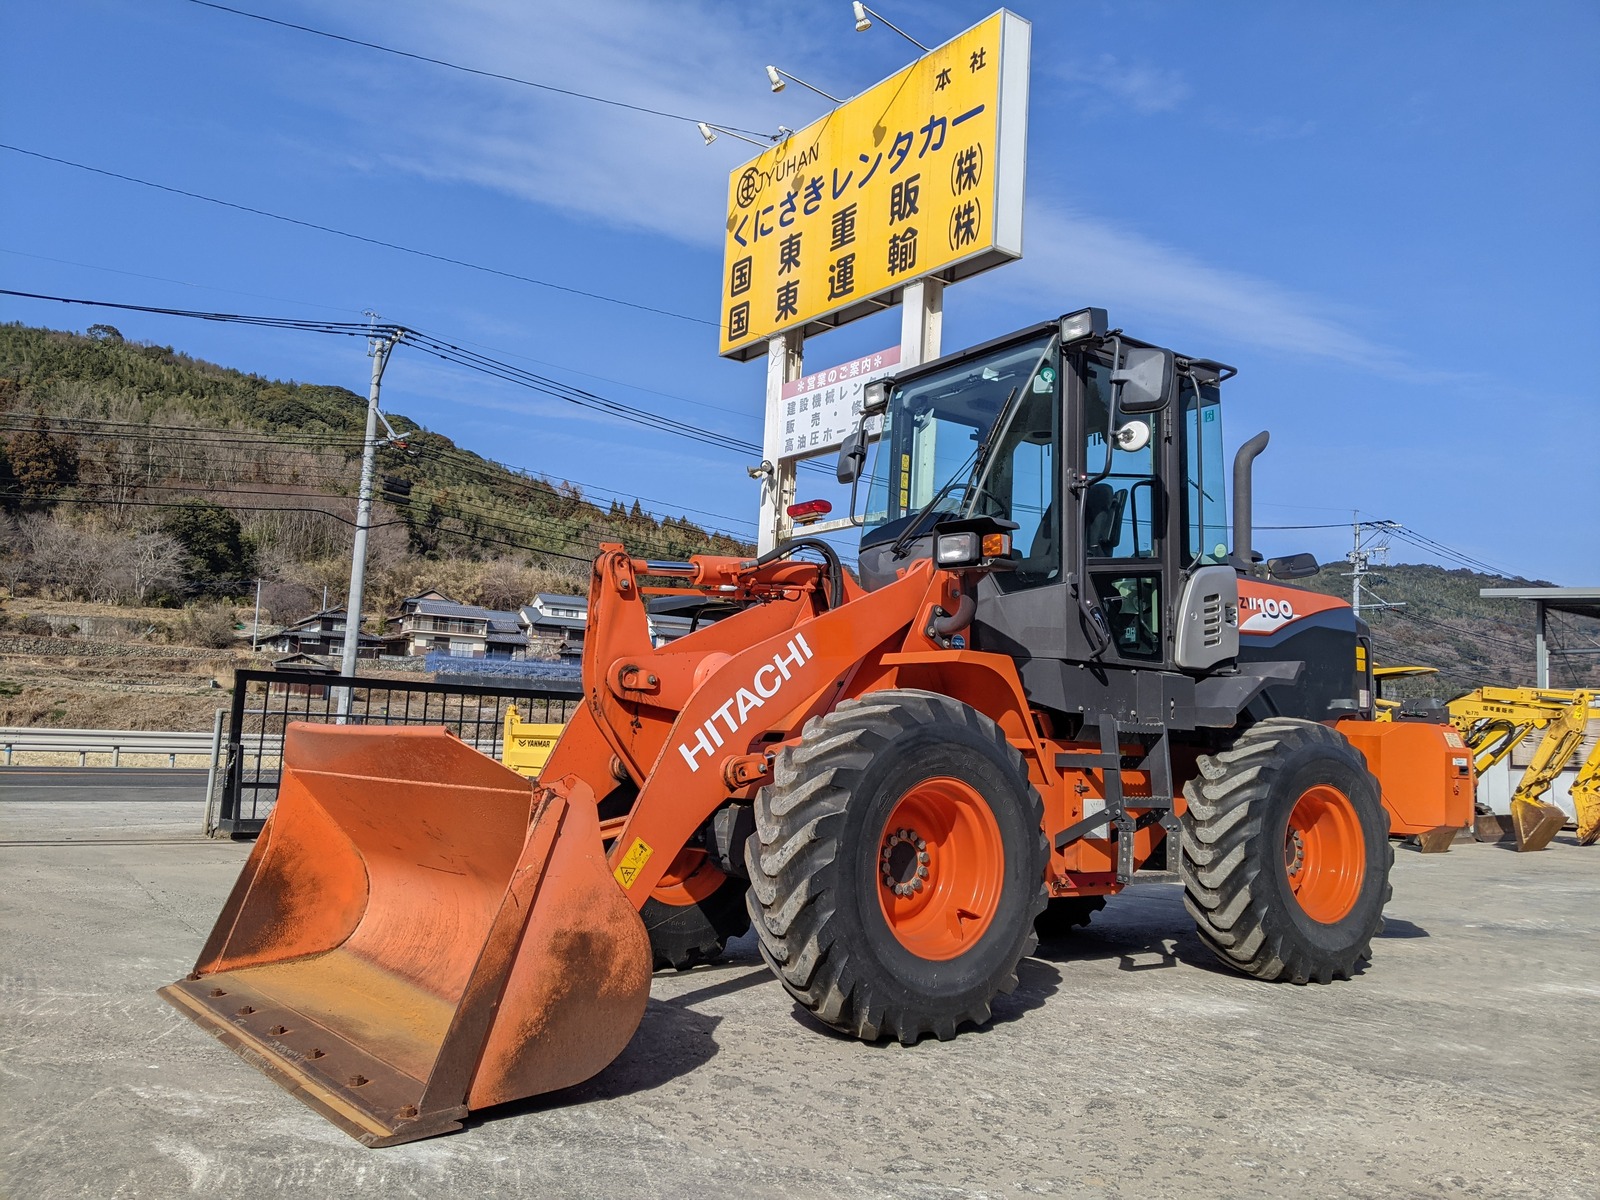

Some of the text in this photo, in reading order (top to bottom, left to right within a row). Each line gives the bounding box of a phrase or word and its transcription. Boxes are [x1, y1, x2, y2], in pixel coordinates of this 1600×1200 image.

[935, 48, 987, 91] 本社
[734, 104, 985, 247] くにさきレンタカー
[787, 372, 889, 417] 建設機械レン
[678, 632, 814, 772] HITACHI
